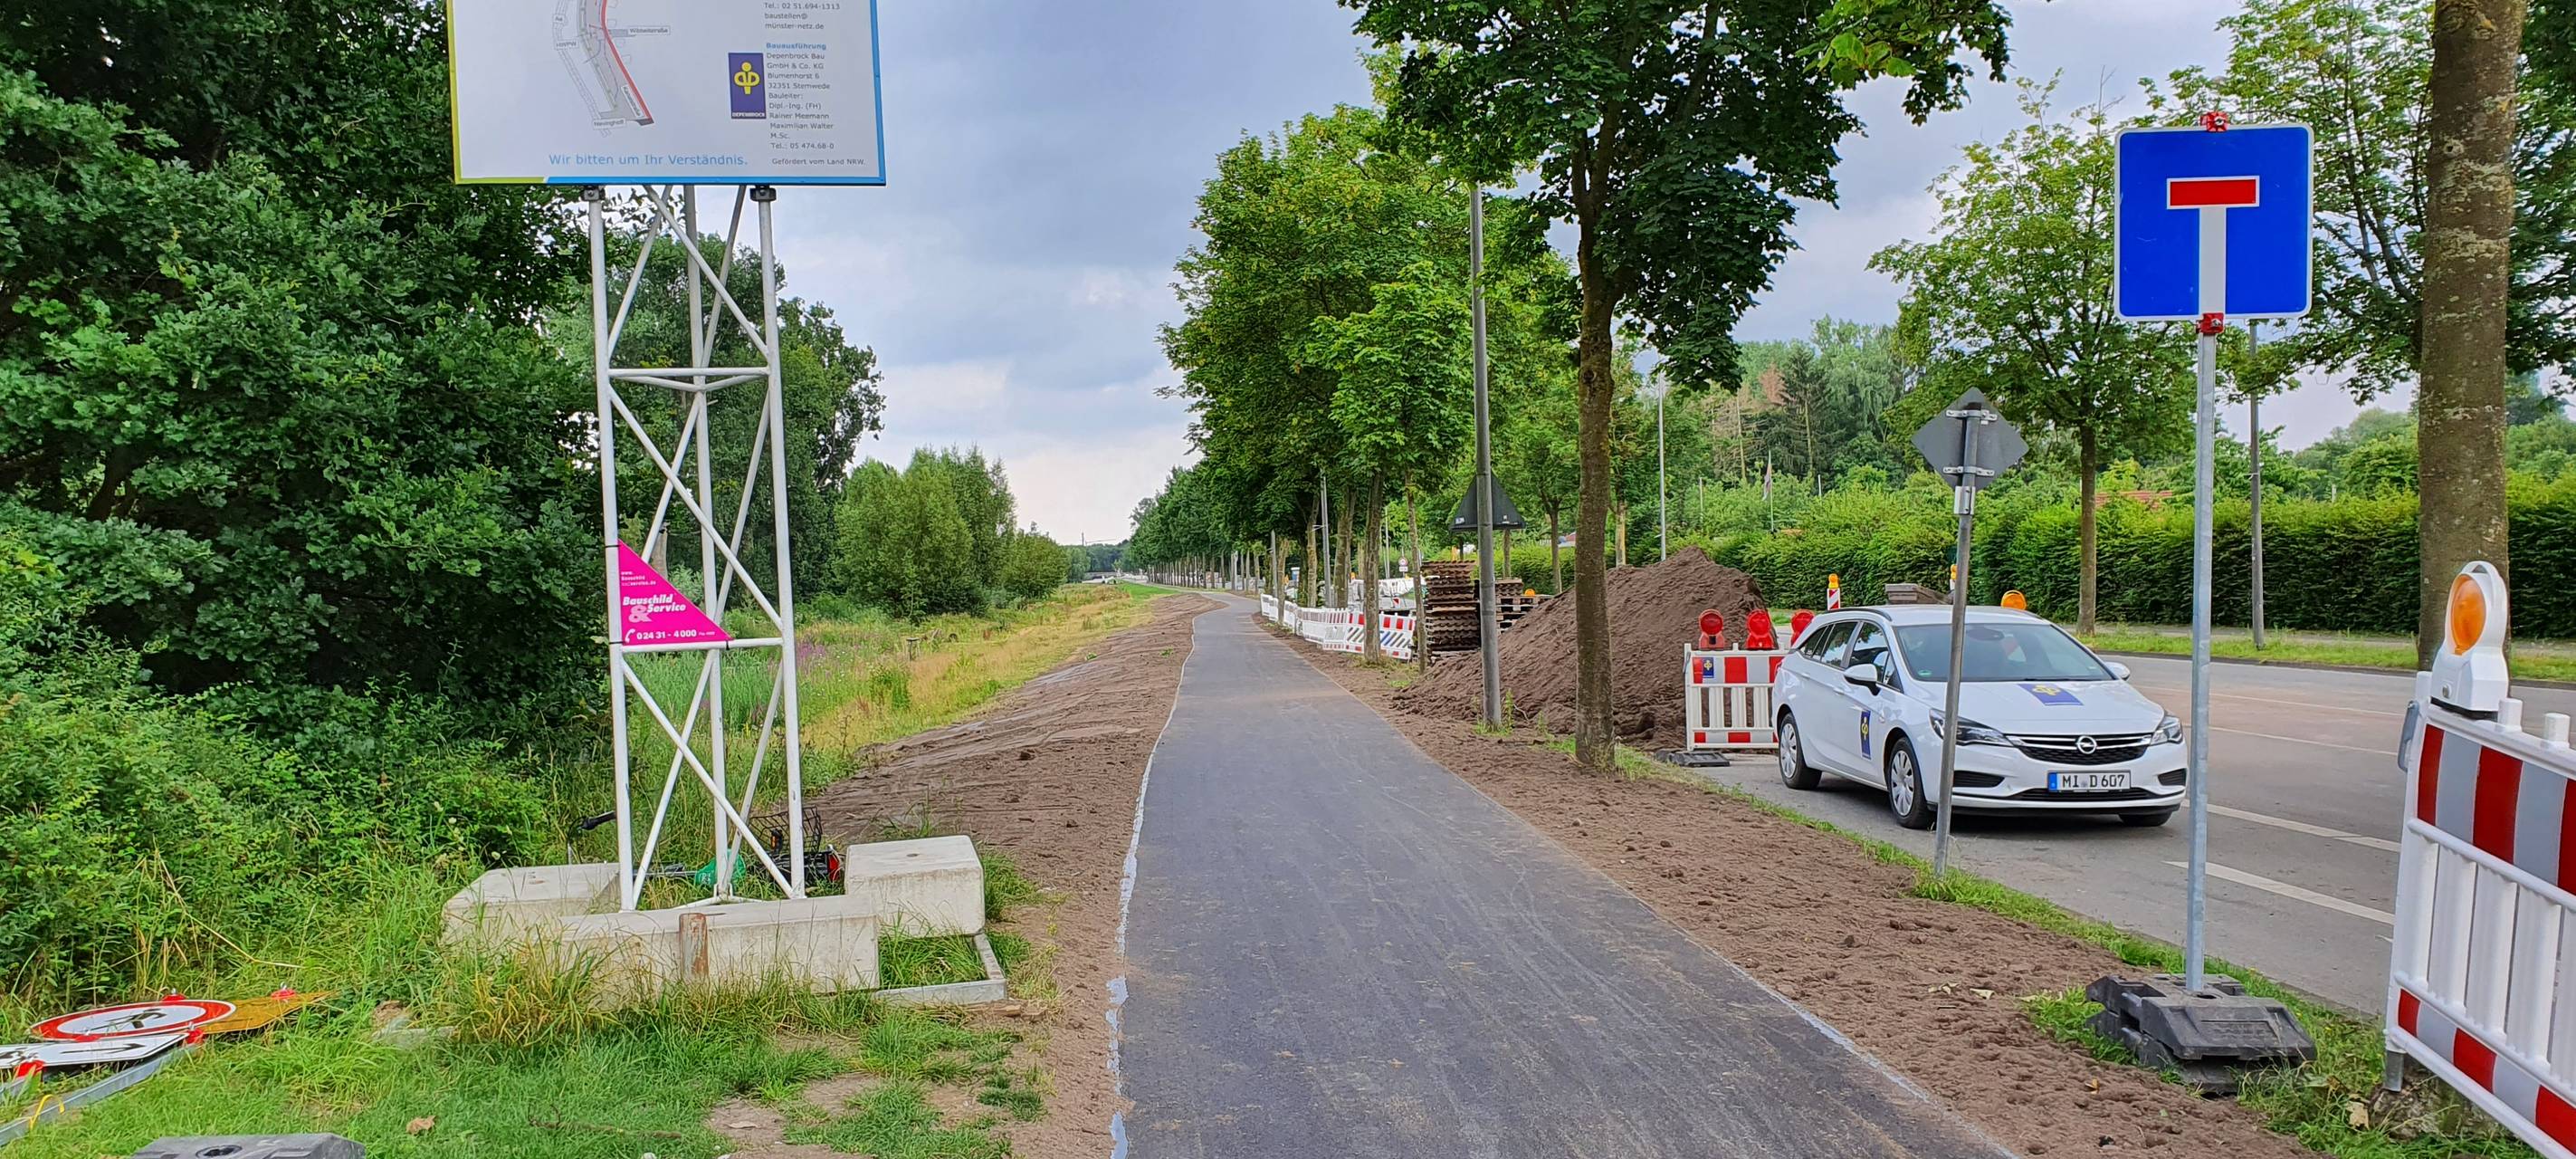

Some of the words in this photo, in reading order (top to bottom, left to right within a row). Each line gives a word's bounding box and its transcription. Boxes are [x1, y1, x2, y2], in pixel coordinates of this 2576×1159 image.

[766, 43, 826, 51] Bauausführung
[806, 102, 822, 110] (FH)
[549, 154, 571, 165] Wir
[576, 153, 615, 165] bitten
[618, 156, 639, 166] um
[644, 154, 663, 165] Ihr
[668, 153, 749, 165] Verständnis.
[623, 594, 673, 606] Bauschild
[628, 605, 652, 623] &
[647, 602, 686, 613] Service
[2063, 775, 2079, 788] MI
[2089, 775, 2098, 787] D
[2101, 775, 2125, 787] 607
